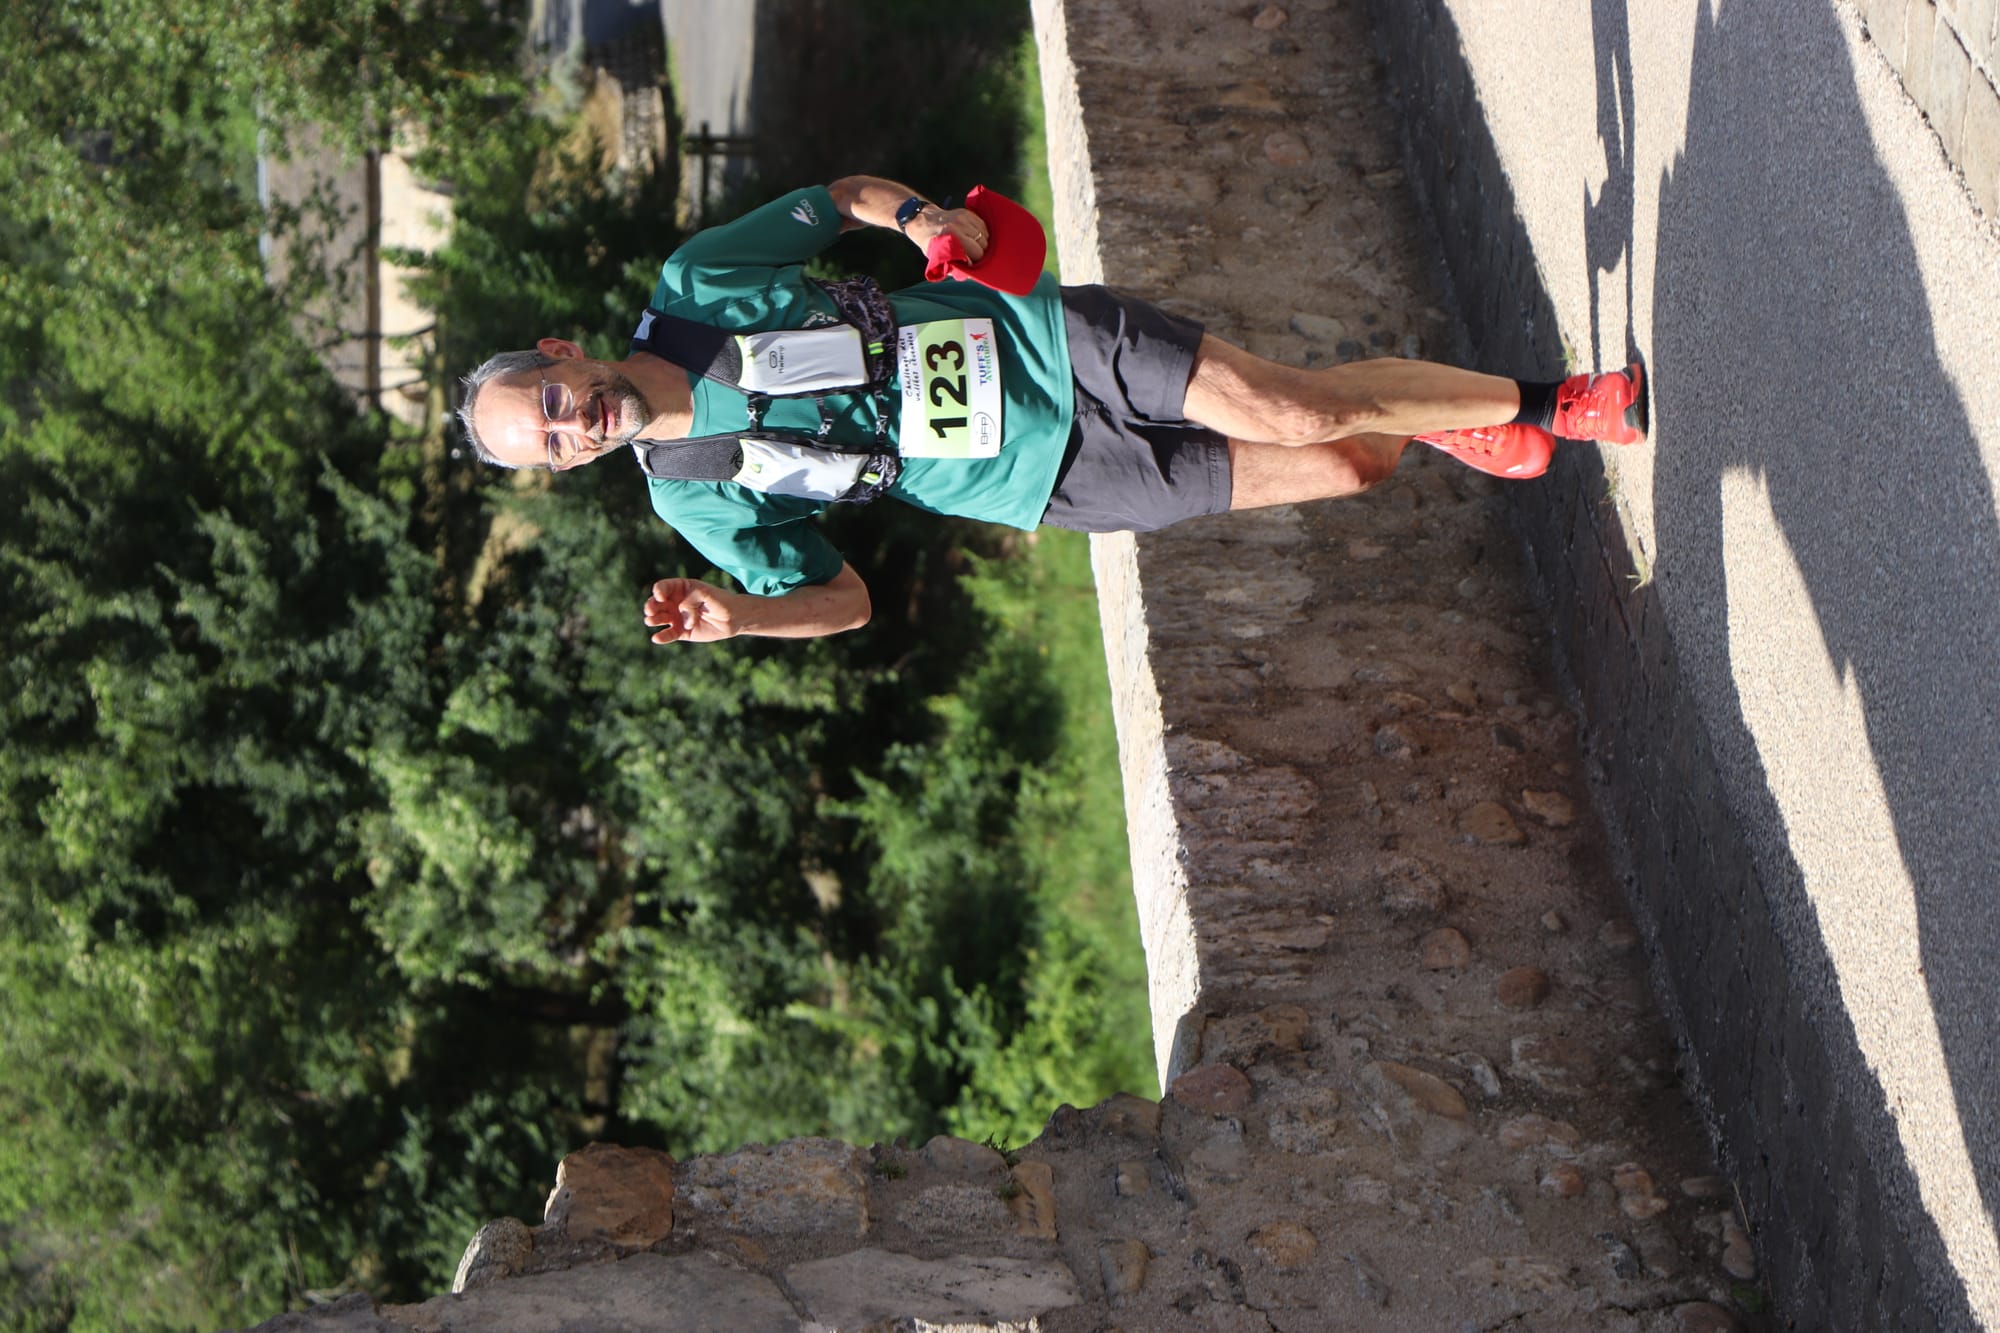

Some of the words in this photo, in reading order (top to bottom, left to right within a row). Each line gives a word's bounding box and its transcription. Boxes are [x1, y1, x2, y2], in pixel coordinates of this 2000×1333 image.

[902, 356, 912, 396] Challenge
[976, 345, 986, 386] TUFF'S
[983, 341, 992, 381] Aventure
[925, 340, 967, 439] 123
[980, 417, 989, 445] BFP
